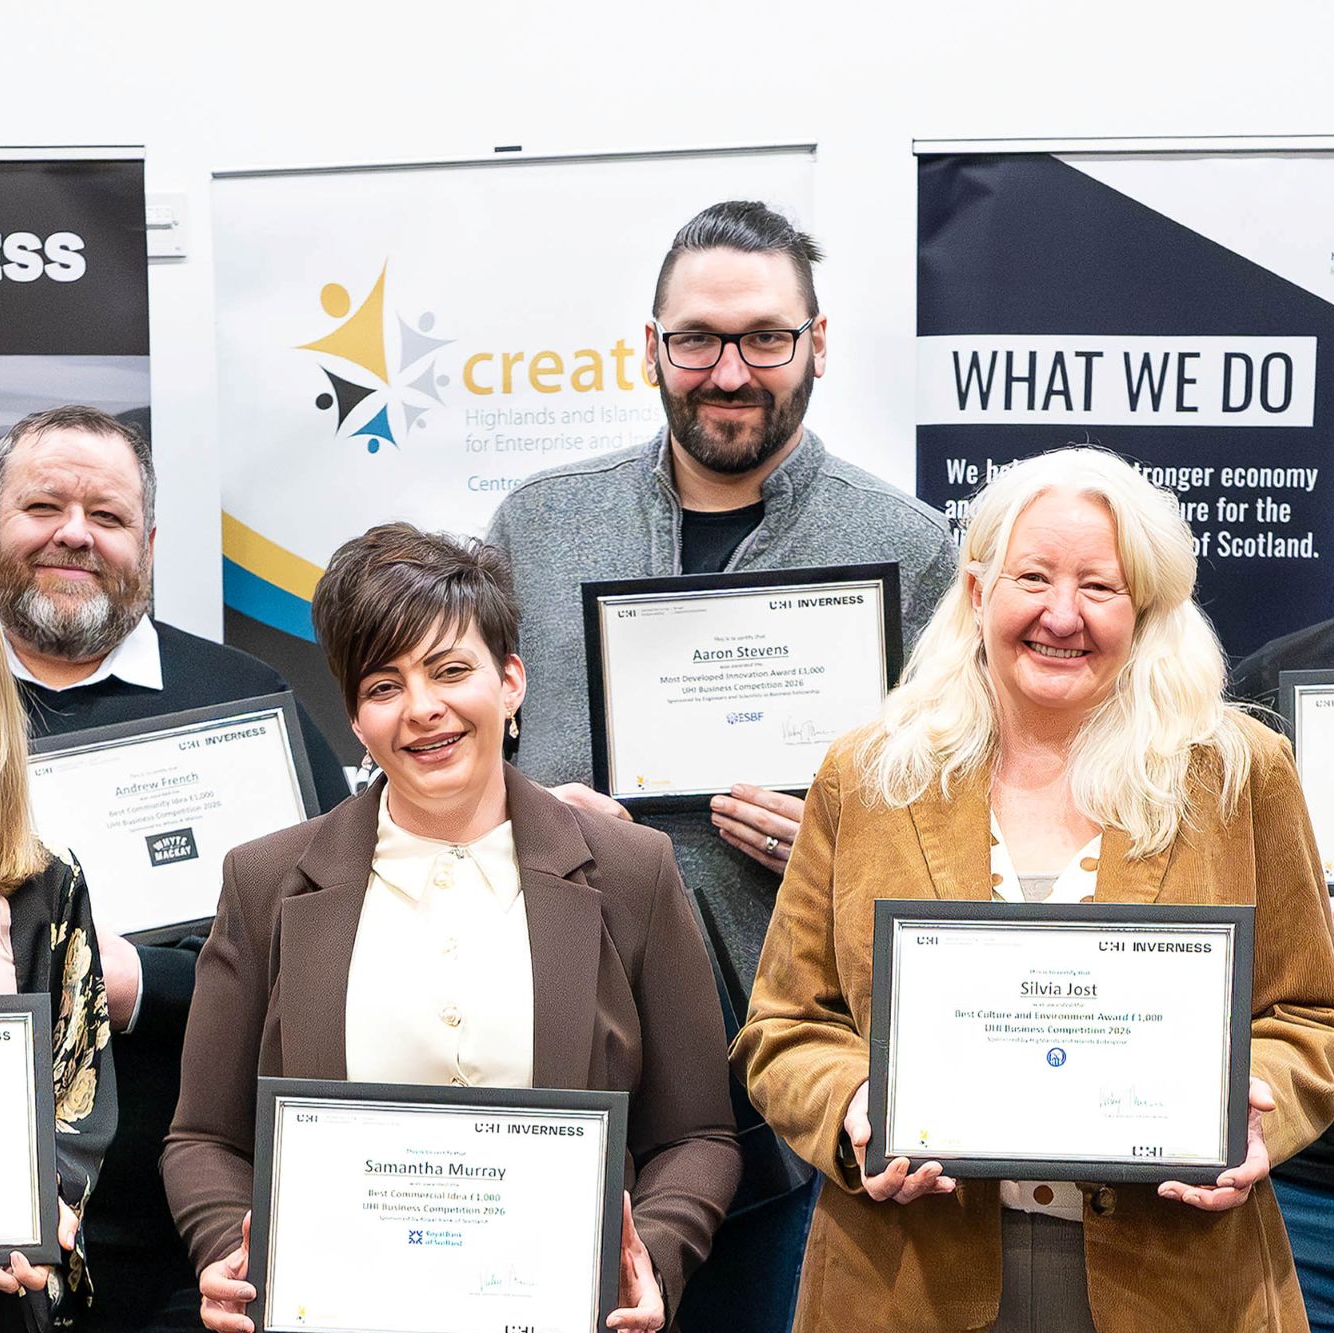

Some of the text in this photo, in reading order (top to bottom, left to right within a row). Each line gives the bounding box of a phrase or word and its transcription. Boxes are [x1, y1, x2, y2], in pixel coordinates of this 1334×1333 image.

[952, 351, 1293, 413] WHAT WE DO
[466, 408, 555, 431] Highlands
[561, 408, 594, 424] and
[466, 435, 489, 452] for
[495, 433, 583, 454] Enterprise
[590, 433, 623, 449] and
[947, 459, 1318, 491] We tronger economy
[1217, 498, 1247, 522] for
[1257, 497, 1291, 522] the
[1217, 530, 1318, 558] Scotland.
[769, 595, 864, 609] UHI INVERNESS
[618, 610, 636, 618] UHI
[693, 645, 788, 661] Aaron Stevens
[660, 676, 680, 684] Most
[682, 673, 723, 683] Developed
[726, 671, 768, 680] Innovation
[699, 685, 731, 693] Business
[734, 682, 783, 691] Competition
[785, 680, 804, 688] 2026
[738, 712, 764, 722] ESBF
[179, 727, 266, 751] UHI INVERNESS
[116, 782, 158, 796] Andrew
[162, 772, 198, 786] French
[153, 836, 188, 851] WHYTE
[154, 845, 191, 860] MACKAY
[917, 936, 939, 945] UHI
[1099, 941, 1212, 953] UHI INVERNESS
[1021, 981, 1098, 996] Silvia Jost
[955, 1010, 1162, 1022] Best Culture and Environment Award £1,000
[985, 1024, 1131, 1035] UHI Business Competition 2026
[296, 1114, 318, 1122] UHI
[475, 1122, 584, 1137] UHI INVERNESS
[1132, 1146, 1163, 1158] UHI
[365, 1160, 506, 1180] Samantha Murray
[382, 1204, 420, 1212] Business
[424, 1204, 480, 1215] Competition
[483, 1207, 505, 1215] 2026
